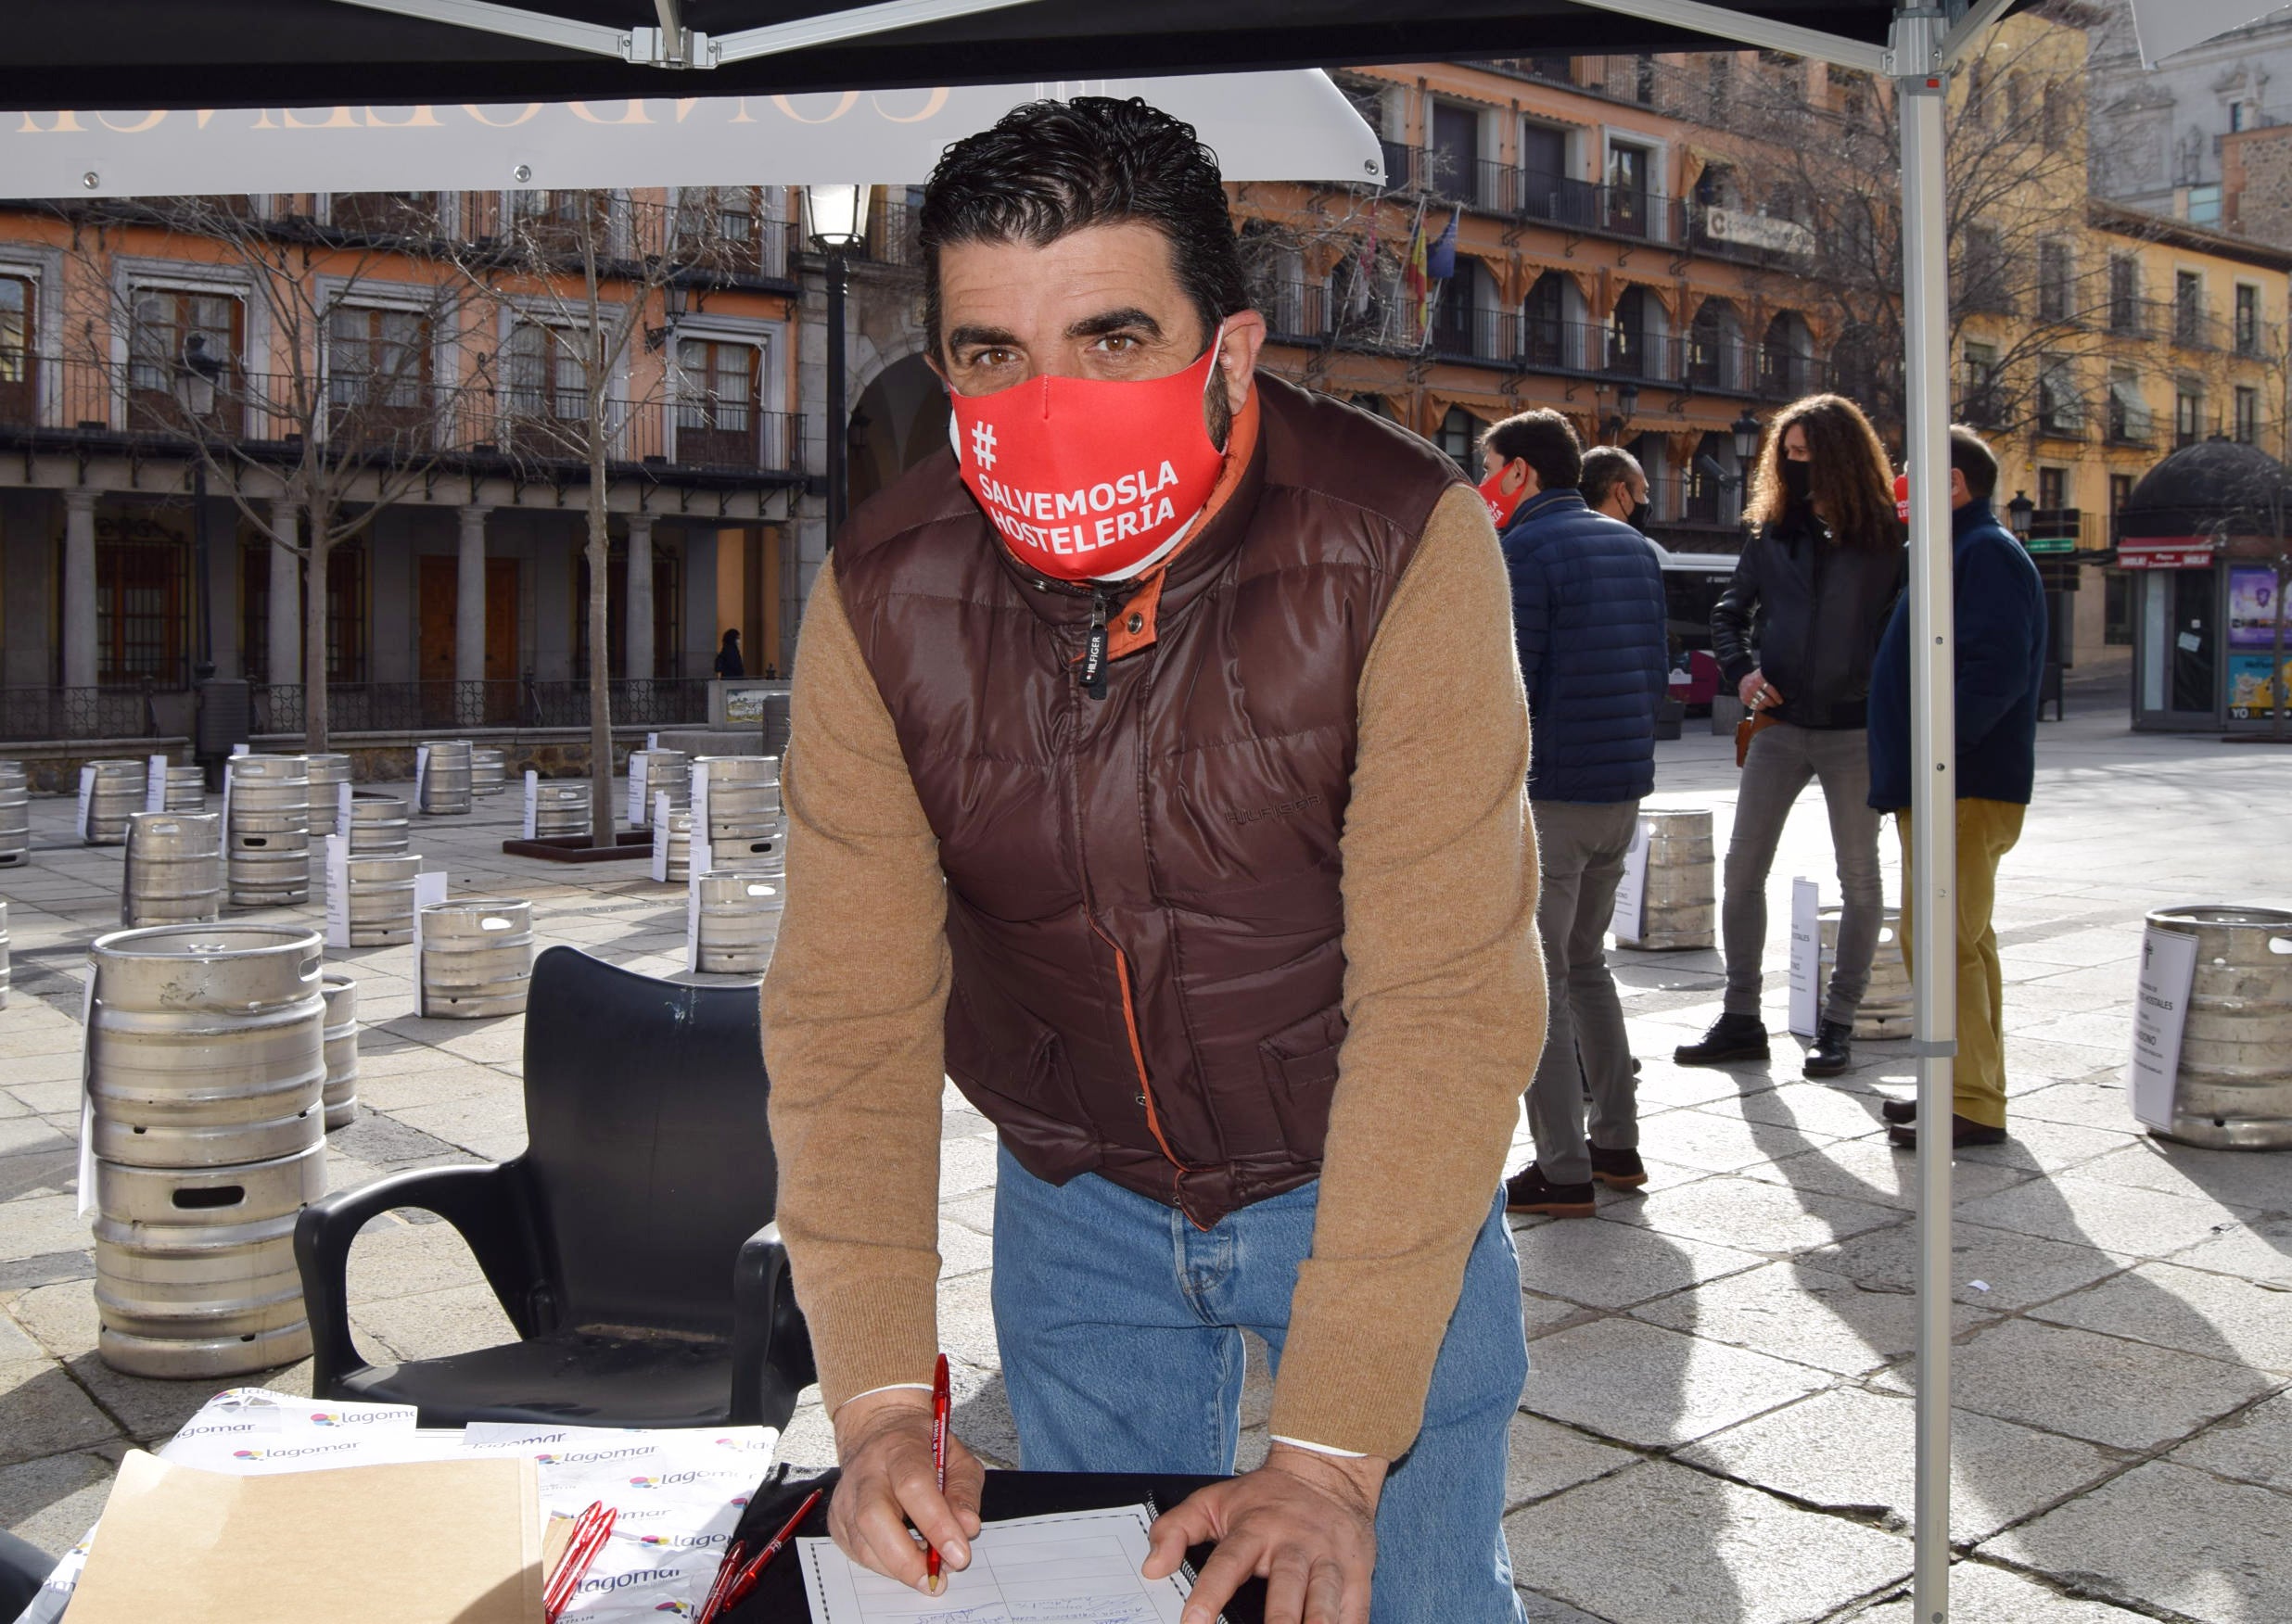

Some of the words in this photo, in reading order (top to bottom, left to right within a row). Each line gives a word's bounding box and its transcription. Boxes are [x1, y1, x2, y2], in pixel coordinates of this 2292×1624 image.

[978, 460, 1179, 521] SALVEMOSLA
[989, 493, 1176, 554] HOSTELERÍA
[1087, 636, 1101, 674] HILFIGER
[341, 1410, 415, 1425] lagom
[176, 1424, 257, 1439] gomar
[266, 1441, 363, 1458] lagomar
[564, 1445, 659, 1464] lagomar
